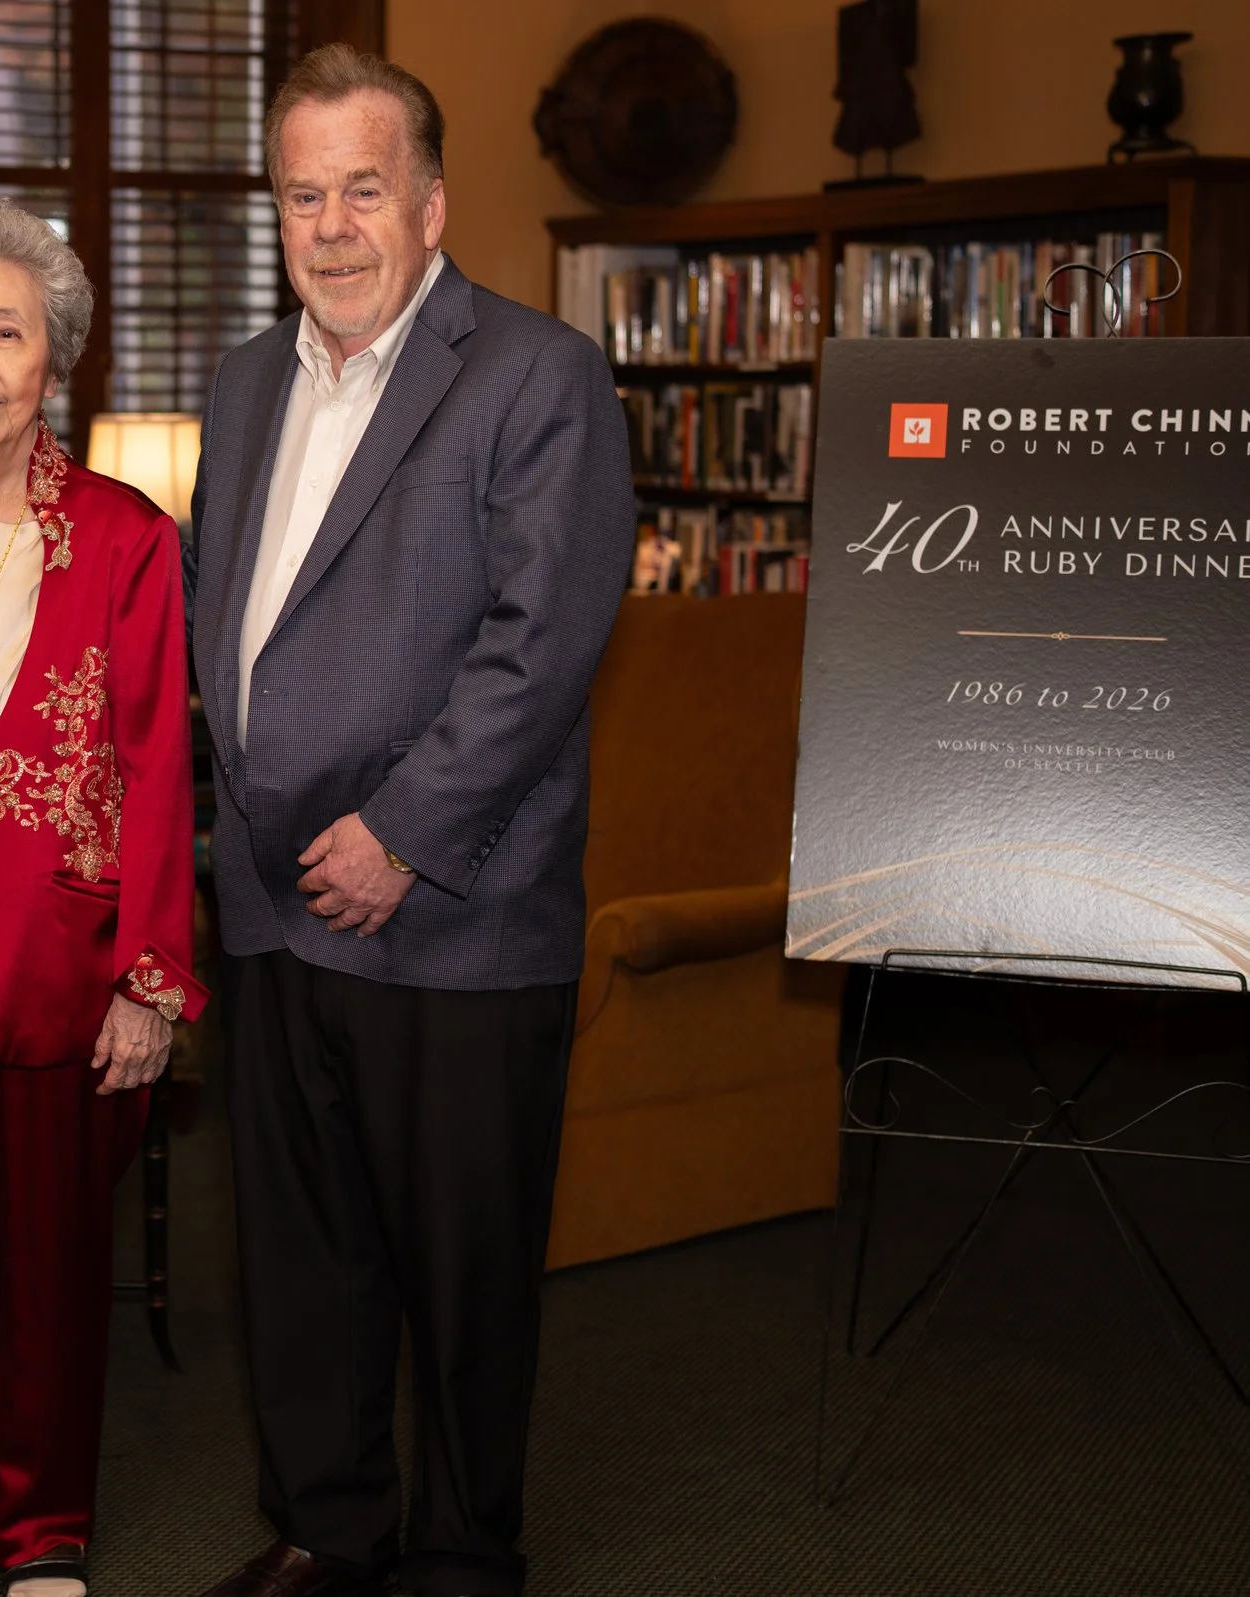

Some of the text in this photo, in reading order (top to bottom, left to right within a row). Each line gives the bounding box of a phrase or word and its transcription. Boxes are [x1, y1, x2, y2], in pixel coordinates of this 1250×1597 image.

[962, 408, 1113, 432] ROBERT
[961, 439, 1250, 456] FOUNDATIO
[1000, 515, 1250, 543] ANNIVERSA
[1004, 550, 1103, 575] RUBY
[946, 680, 1174, 712] 1986 to 2026
[937, 739, 1176, 761] WOMEN'S UNIVERSITY CLUB
[1004, 759, 1103, 774] OF SEATTLE
